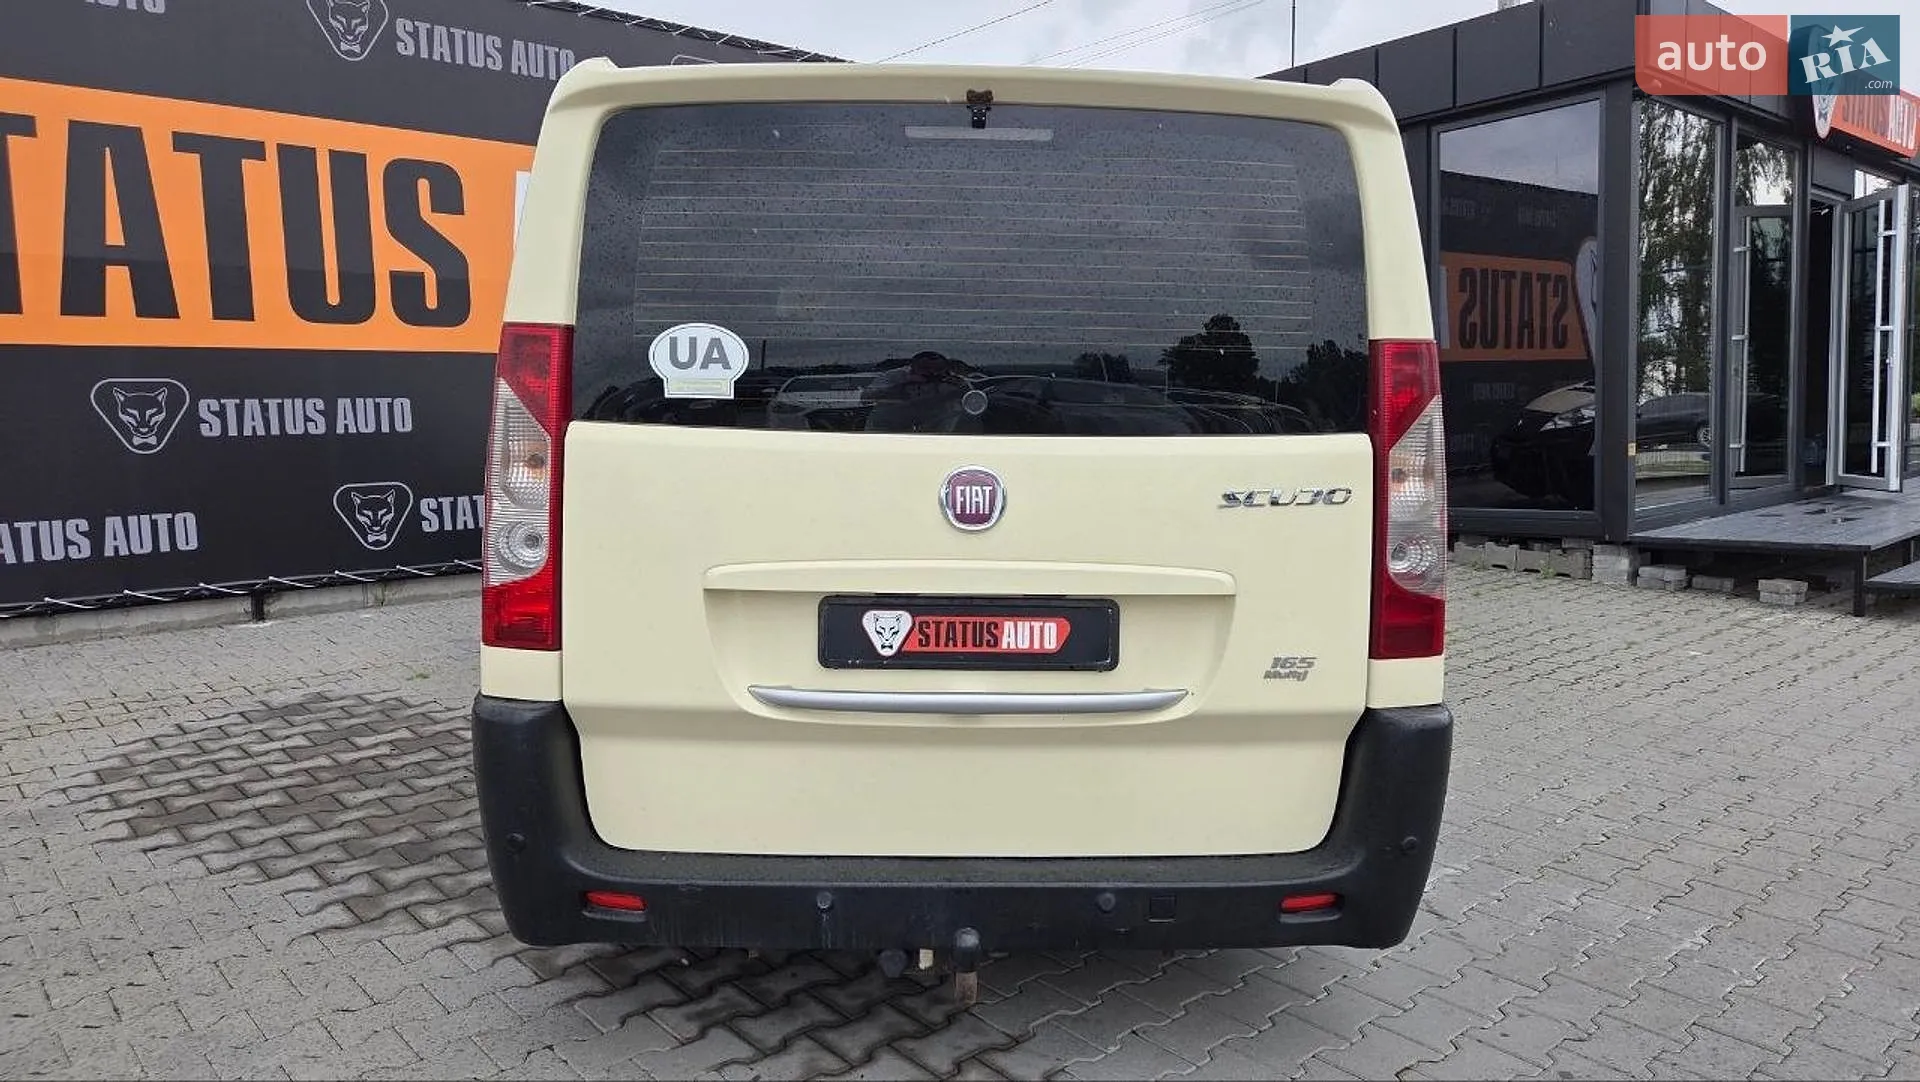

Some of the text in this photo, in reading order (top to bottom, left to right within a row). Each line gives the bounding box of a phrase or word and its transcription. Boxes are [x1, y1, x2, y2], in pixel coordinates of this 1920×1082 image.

[396, 18, 503, 71] STATUS
[669, 336, 732, 370] UA
[198, 397, 413, 437] STATUS AUTO
[955, 486, 993, 514] FIAT
[1217, 488, 1352, 508] SCUDO
[104, 511, 198, 557] AUTO
[917, 620, 1057, 650] STATUS AUTO
[1271, 657, 1317, 668] 165
